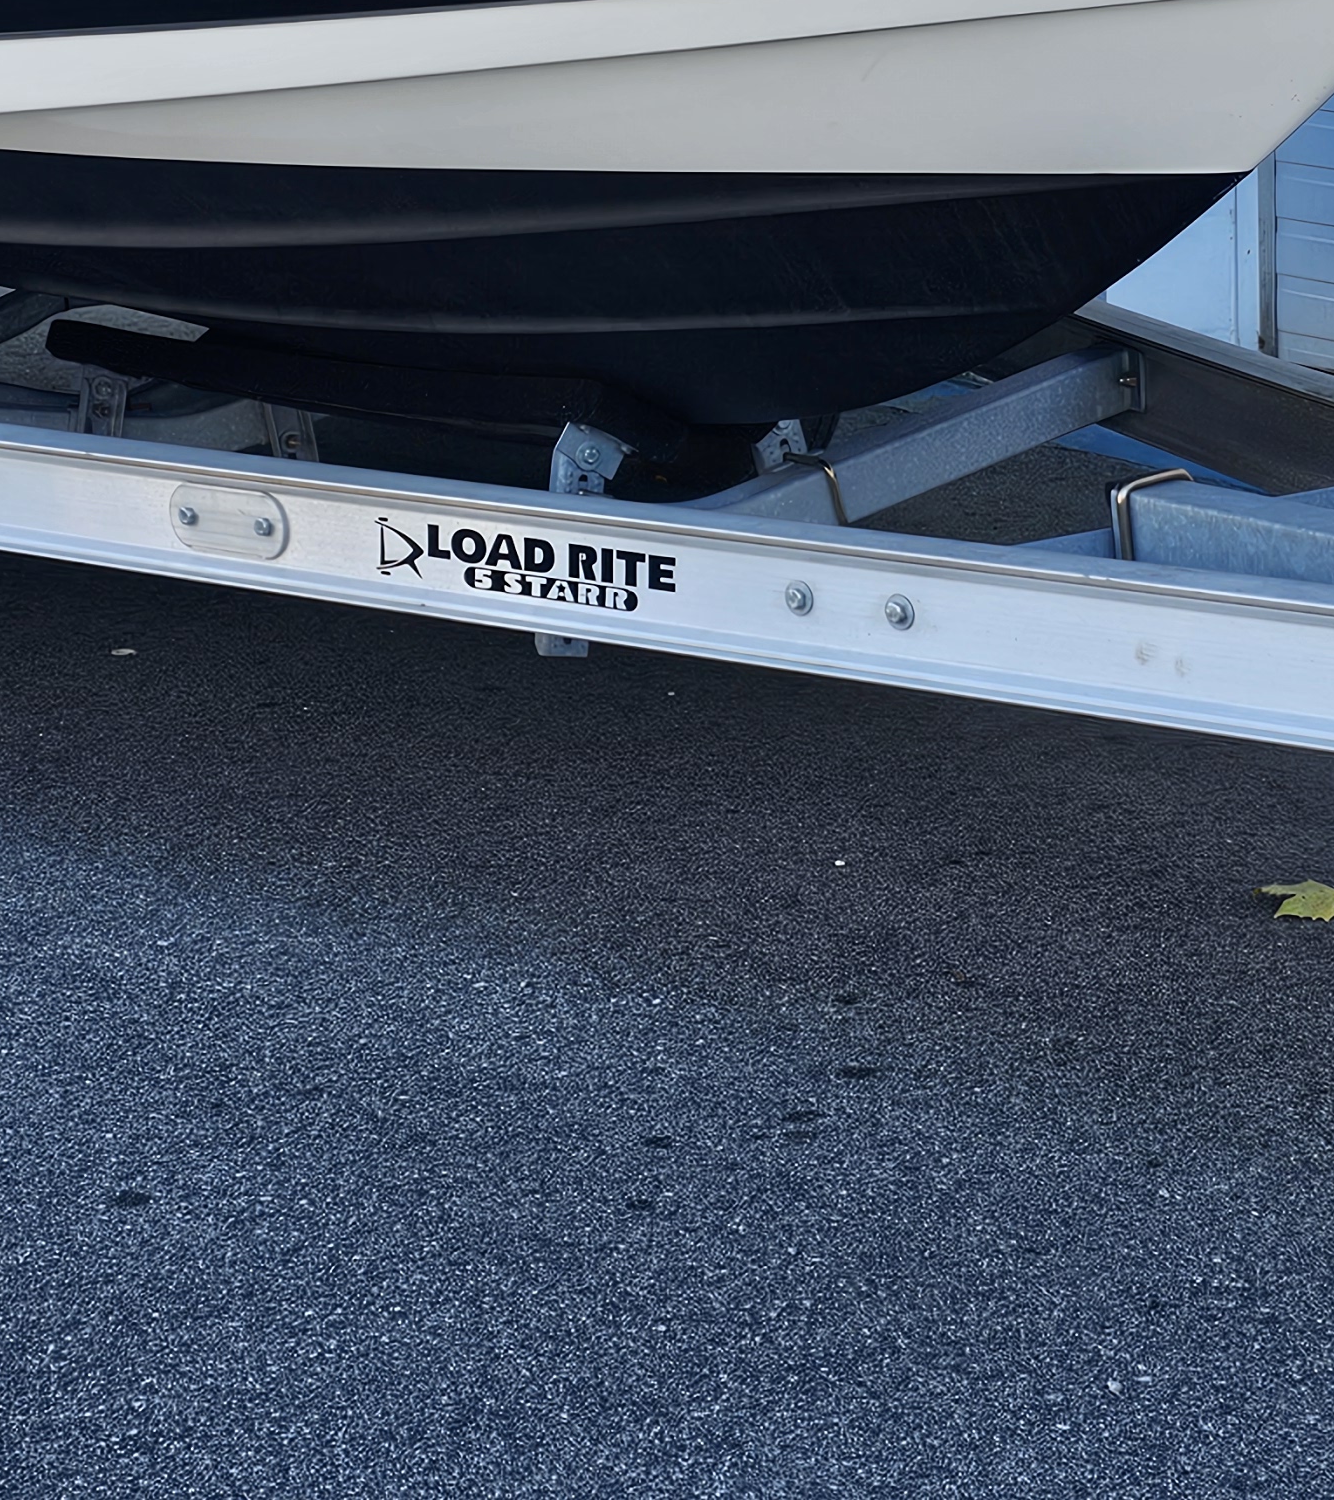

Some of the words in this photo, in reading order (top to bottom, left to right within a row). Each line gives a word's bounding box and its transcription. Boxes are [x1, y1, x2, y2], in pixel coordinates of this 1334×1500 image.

[426, 522, 555, 574] LOAD
[568, 542, 677, 593] RITE
[473, 568, 494, 590] 5
[503, 572, 629, 611] STARR
